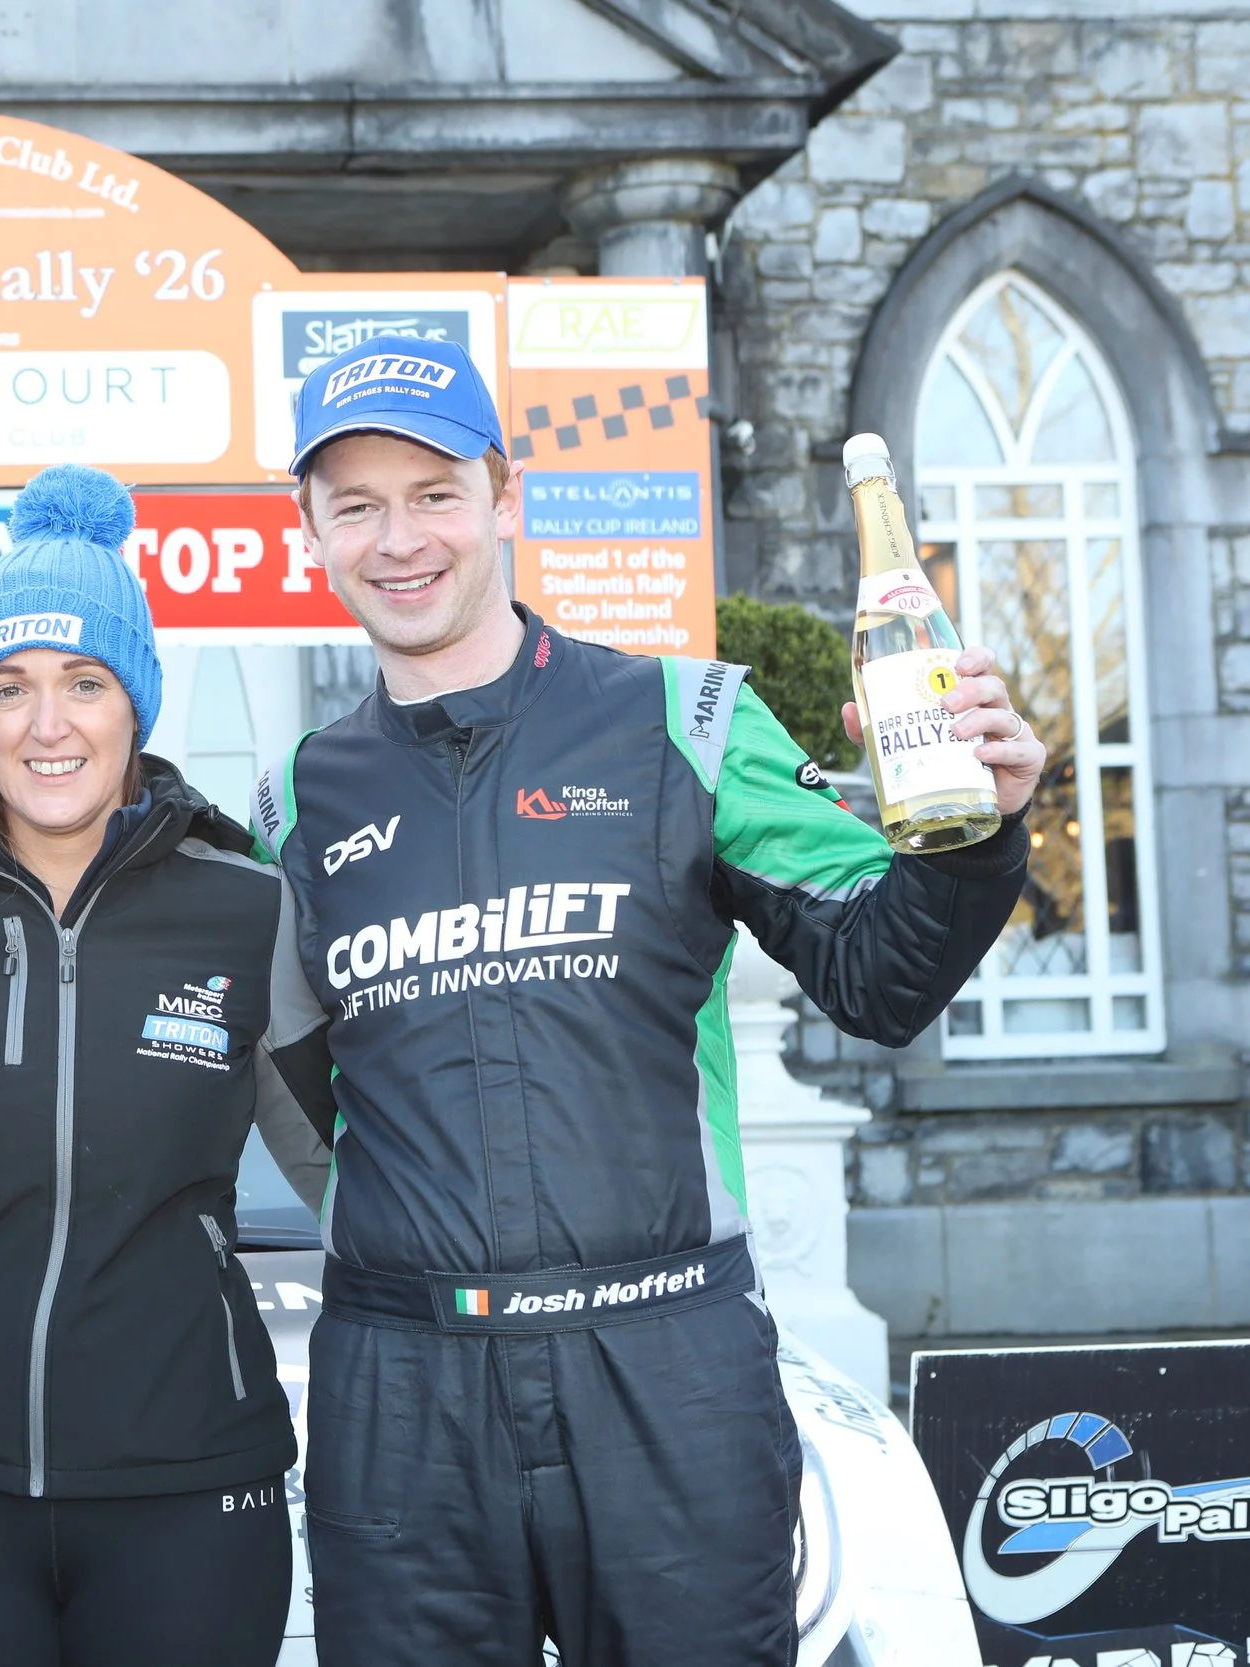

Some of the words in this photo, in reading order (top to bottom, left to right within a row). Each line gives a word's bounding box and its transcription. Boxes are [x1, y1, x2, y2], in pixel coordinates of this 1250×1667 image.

[79, 160, 141, 213] Ltd.
[305, 318, 448, 355] Slatt
[331, 358, 446, 395] TRITON
[353, 385, 382, 401] STAGES
[384, 385, 410, 396] RALLY
[9, 427, 87, 447] CLUB
[531, 484, 693, 502] STELLANTIS
[531, 518, 583, 535] RALLY
[586, 518, 620, 535] CUP
[623, 517, 699, 534] IRELAND
[541, 547, 608, 570] Round
[612, 549, 624, 569] 1
[627, 547, 650, 569] of
[650, 546, 686, 569] the
[541, 573, 634, 595] Stellantis
[637, 573, 687, 598] Rally
[556, 600, 598, 624] Cup
[602, 598, 672, 620] Ireland
[547, 624, 689, 648] hampionship
[689, 662, 729, 739] MARINA
[877, 715, 903, 734] BIRR
[880, 722, 943, 757] RALLY
[256, 767, 280, 838] ARINA
[562, 785, 598, 800] King
[598, 787, 607, 798] &
[570, 798, 630, 811] Moffatt
[323, 815, 401, 876] DSV
[431, 954, 619, 996] INNOVATION
[158, 993, 224, 1019] MIRC
[152, 1020, 224, 1048] TRITON
[136, 1047, 169, 1060] National
[170, 1052, 188, 1063] Rally
[151, 1040, 223, 1060] SHOWERS
[503, 1289, 585, 1315] Josh
[592, 1264, 706, 1308] Moffett
[221, 1486, 276, 1512] BALI
[1003, 1483, 1170, 1524] Sligo
[1164, 1499, 1250, 1537] Pal
